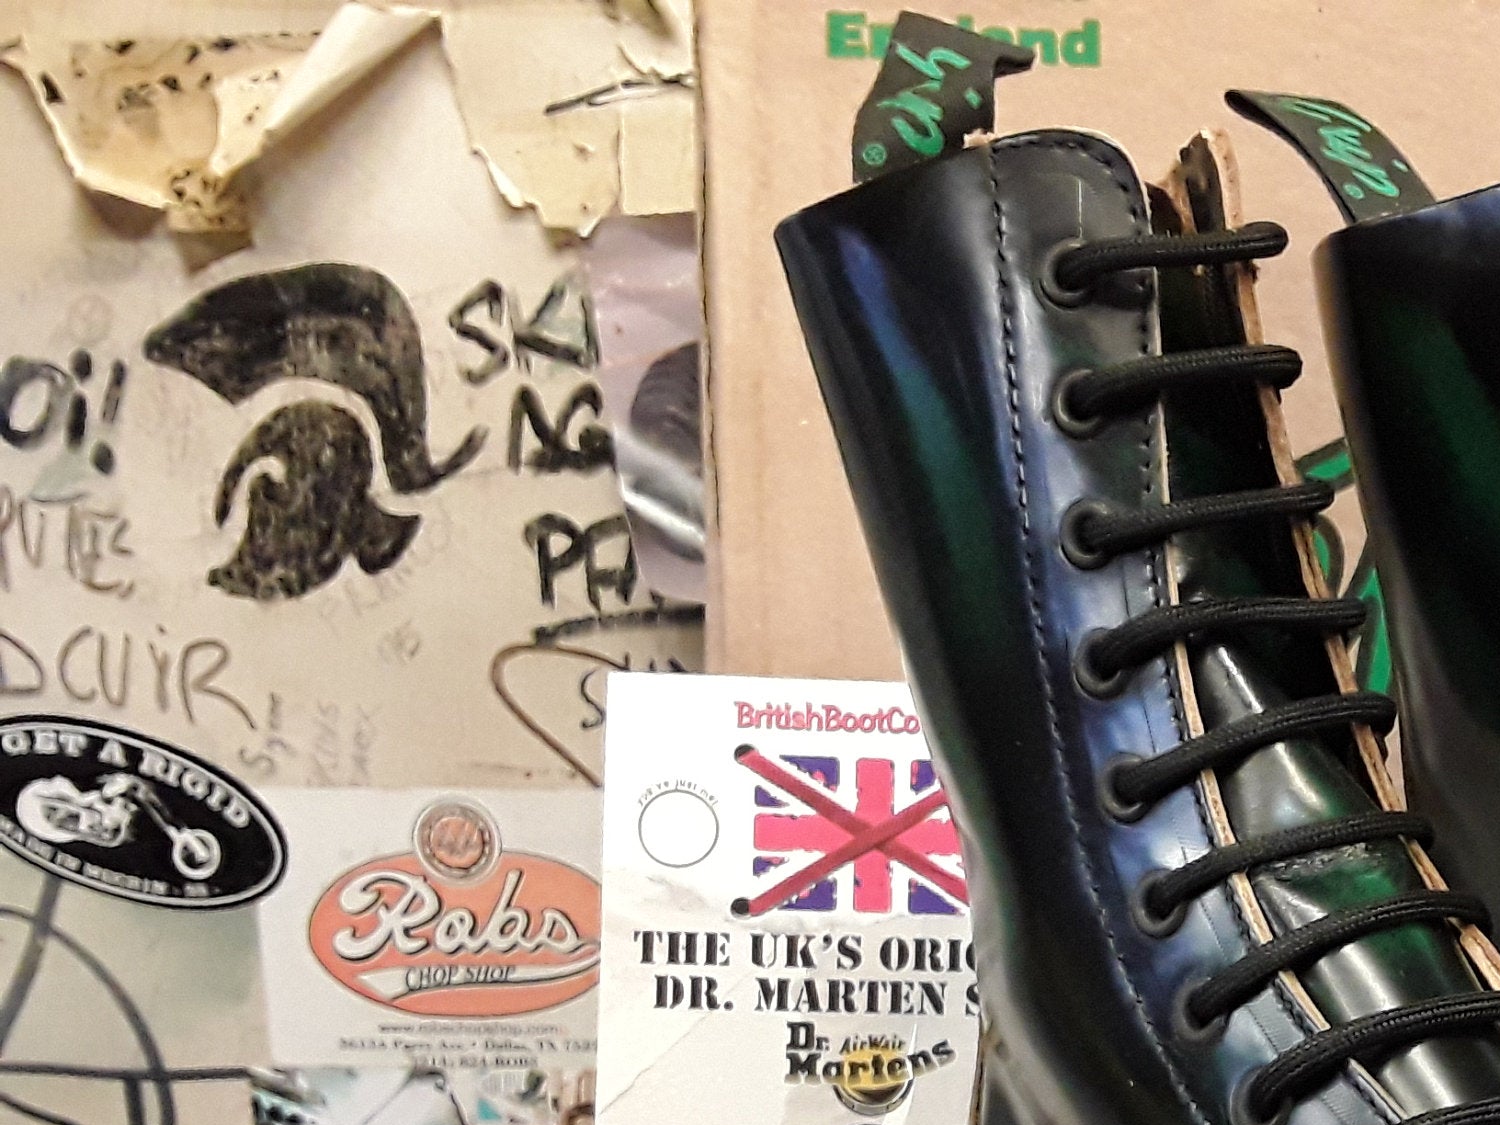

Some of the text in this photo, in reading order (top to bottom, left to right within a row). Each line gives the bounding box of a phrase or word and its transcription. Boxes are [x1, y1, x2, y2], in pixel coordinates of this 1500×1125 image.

[97, 737, 129, 768] A
[634, 930, 731, 966] THE
[750, 933, 862, 970] UK'S
[653, 975, 734, 1011] DR.
[754, 978, 947, 1016] MARTEN
[786, 1021, 829, 1050] Dr.
[785, 1038, 957, 1084] Martens
